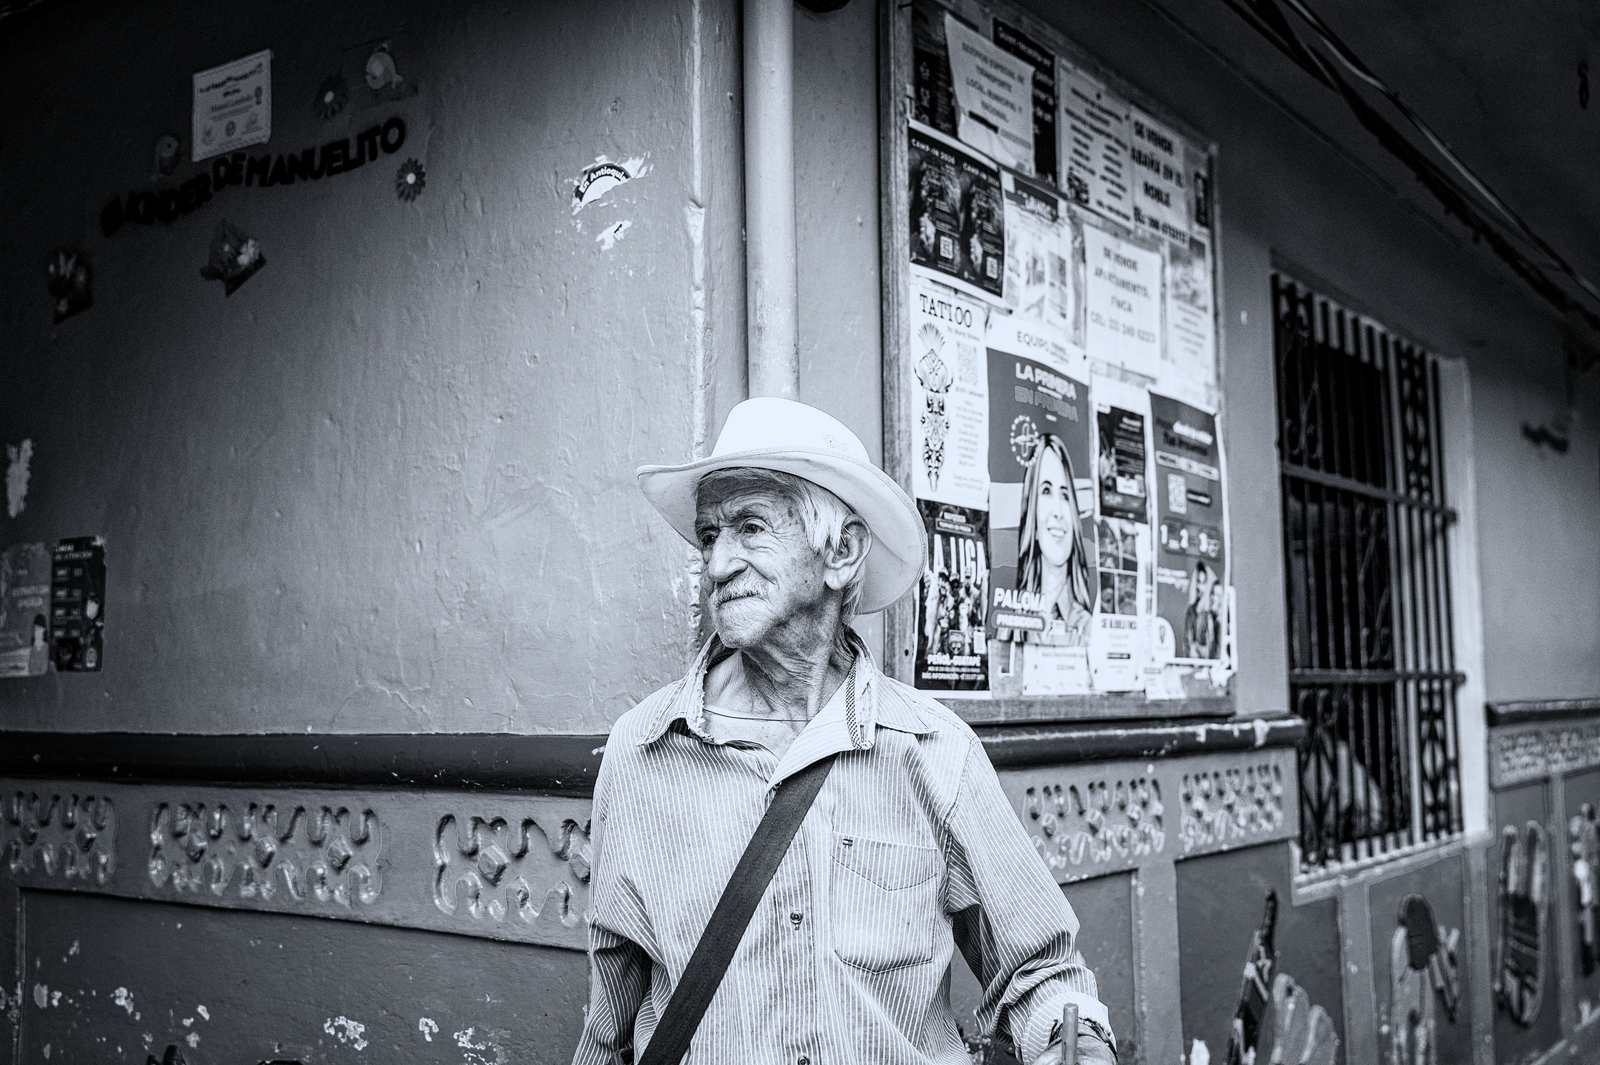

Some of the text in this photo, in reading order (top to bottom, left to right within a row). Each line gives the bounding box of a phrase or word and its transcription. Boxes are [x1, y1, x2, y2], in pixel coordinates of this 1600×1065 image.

[245, 117, 407, 188] MANUELITO
[920, 293, 972, 328] TATTOO
[1015, 362, 1034, 383] LA
